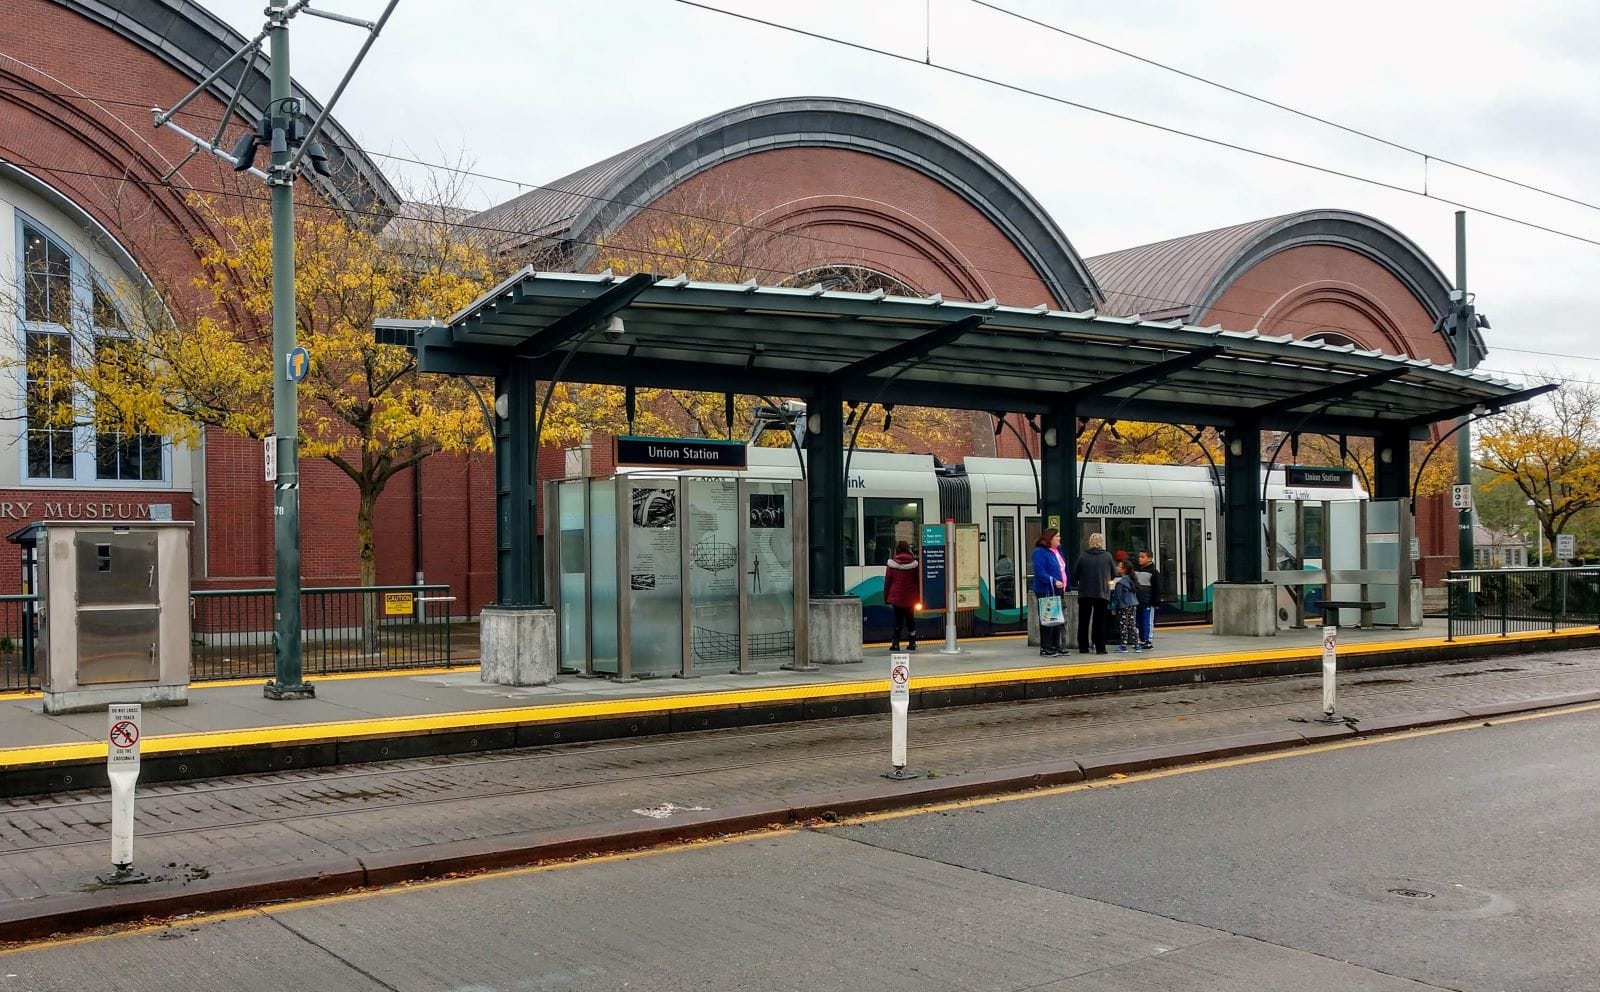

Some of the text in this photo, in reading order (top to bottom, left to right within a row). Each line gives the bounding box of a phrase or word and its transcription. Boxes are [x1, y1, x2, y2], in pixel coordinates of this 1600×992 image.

[648, 446, 719, 460] Union Station
[1304, 472, 1341, 482] Union Station
[43, 503, 151, 519] MUSEUM
